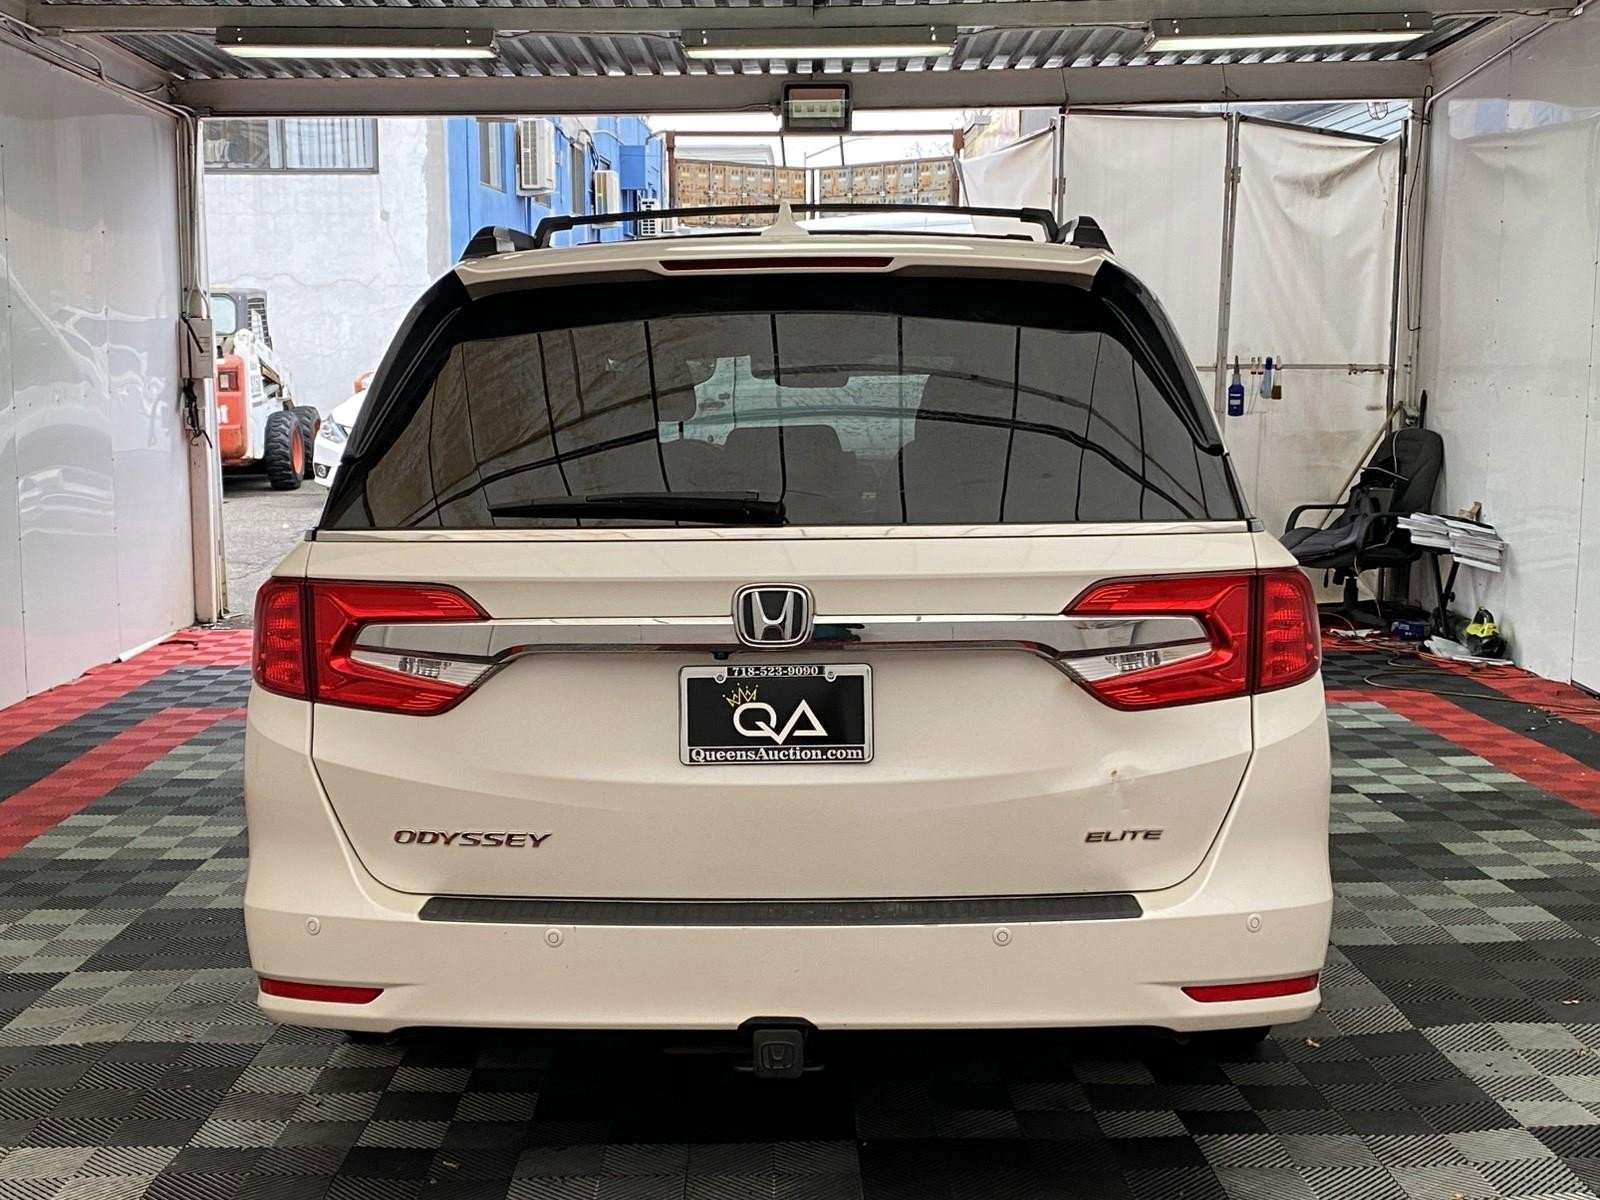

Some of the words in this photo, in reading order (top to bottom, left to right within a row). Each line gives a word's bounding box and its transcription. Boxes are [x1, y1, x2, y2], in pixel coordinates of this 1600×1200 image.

[732, 665, 819, 677] 718-523-9090
[690, 747, 863, 763] QueensAuction.com
[394, 829, 553, 848] ODYSSEY
[1084, 829, 1164, 843] ELITE
